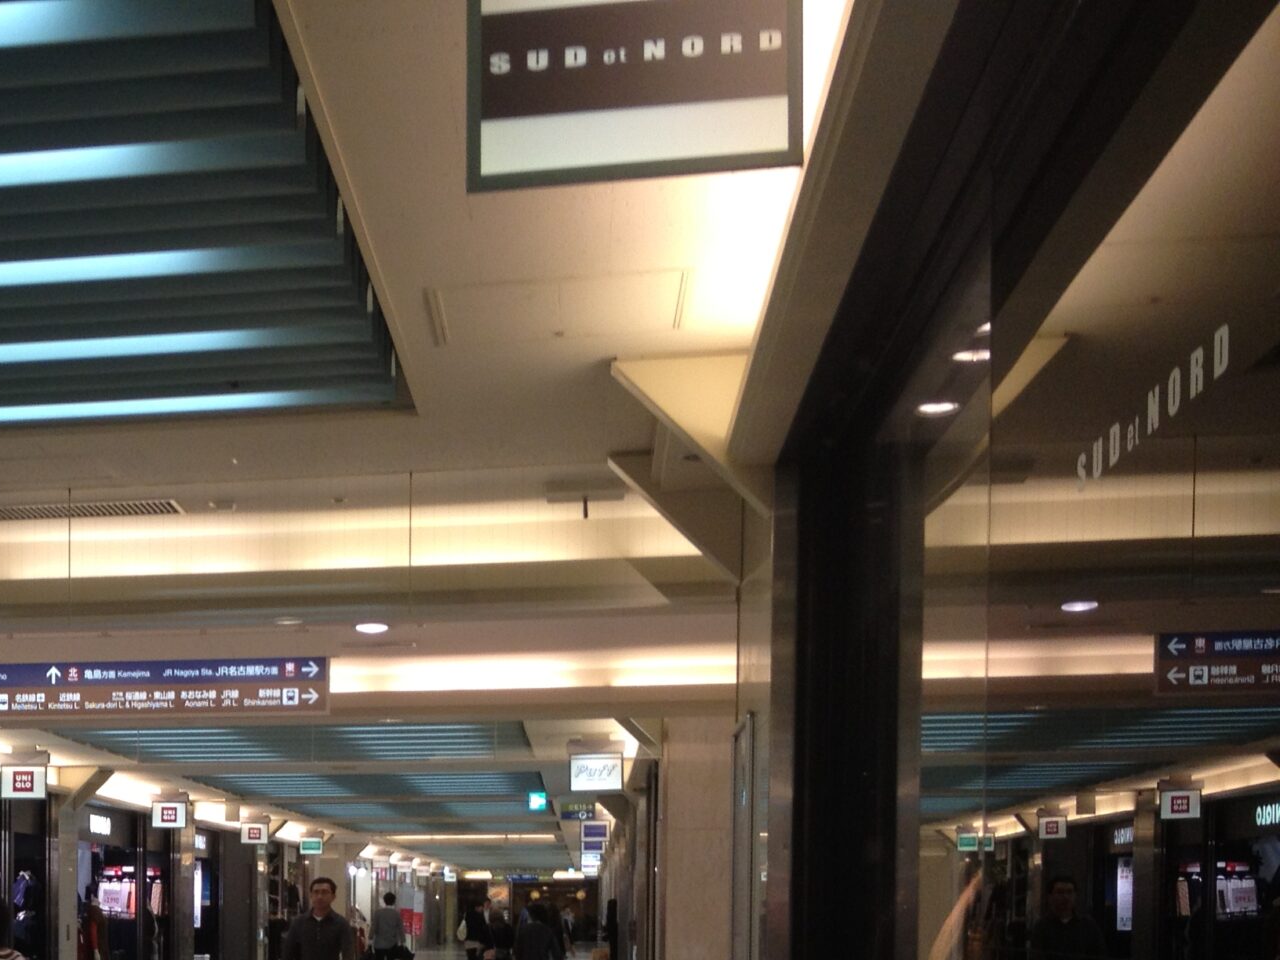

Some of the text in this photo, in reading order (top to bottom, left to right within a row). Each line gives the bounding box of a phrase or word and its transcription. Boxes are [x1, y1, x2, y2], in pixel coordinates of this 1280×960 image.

[490, 29, 782, 75] SUD et NORD
[1076, 323, 1229, 491] SUD et NORD
[68, 667, 78, 678] 北
[163, 669, 172, 677] JR
[174, 668, 199, 678] Nagoya
[221, 690, 239, 699] JR線
[259, 688, 281, 698] 新幹線
[222, 698, 231, 707] JR
[15, 781, 32, 789] QLO
